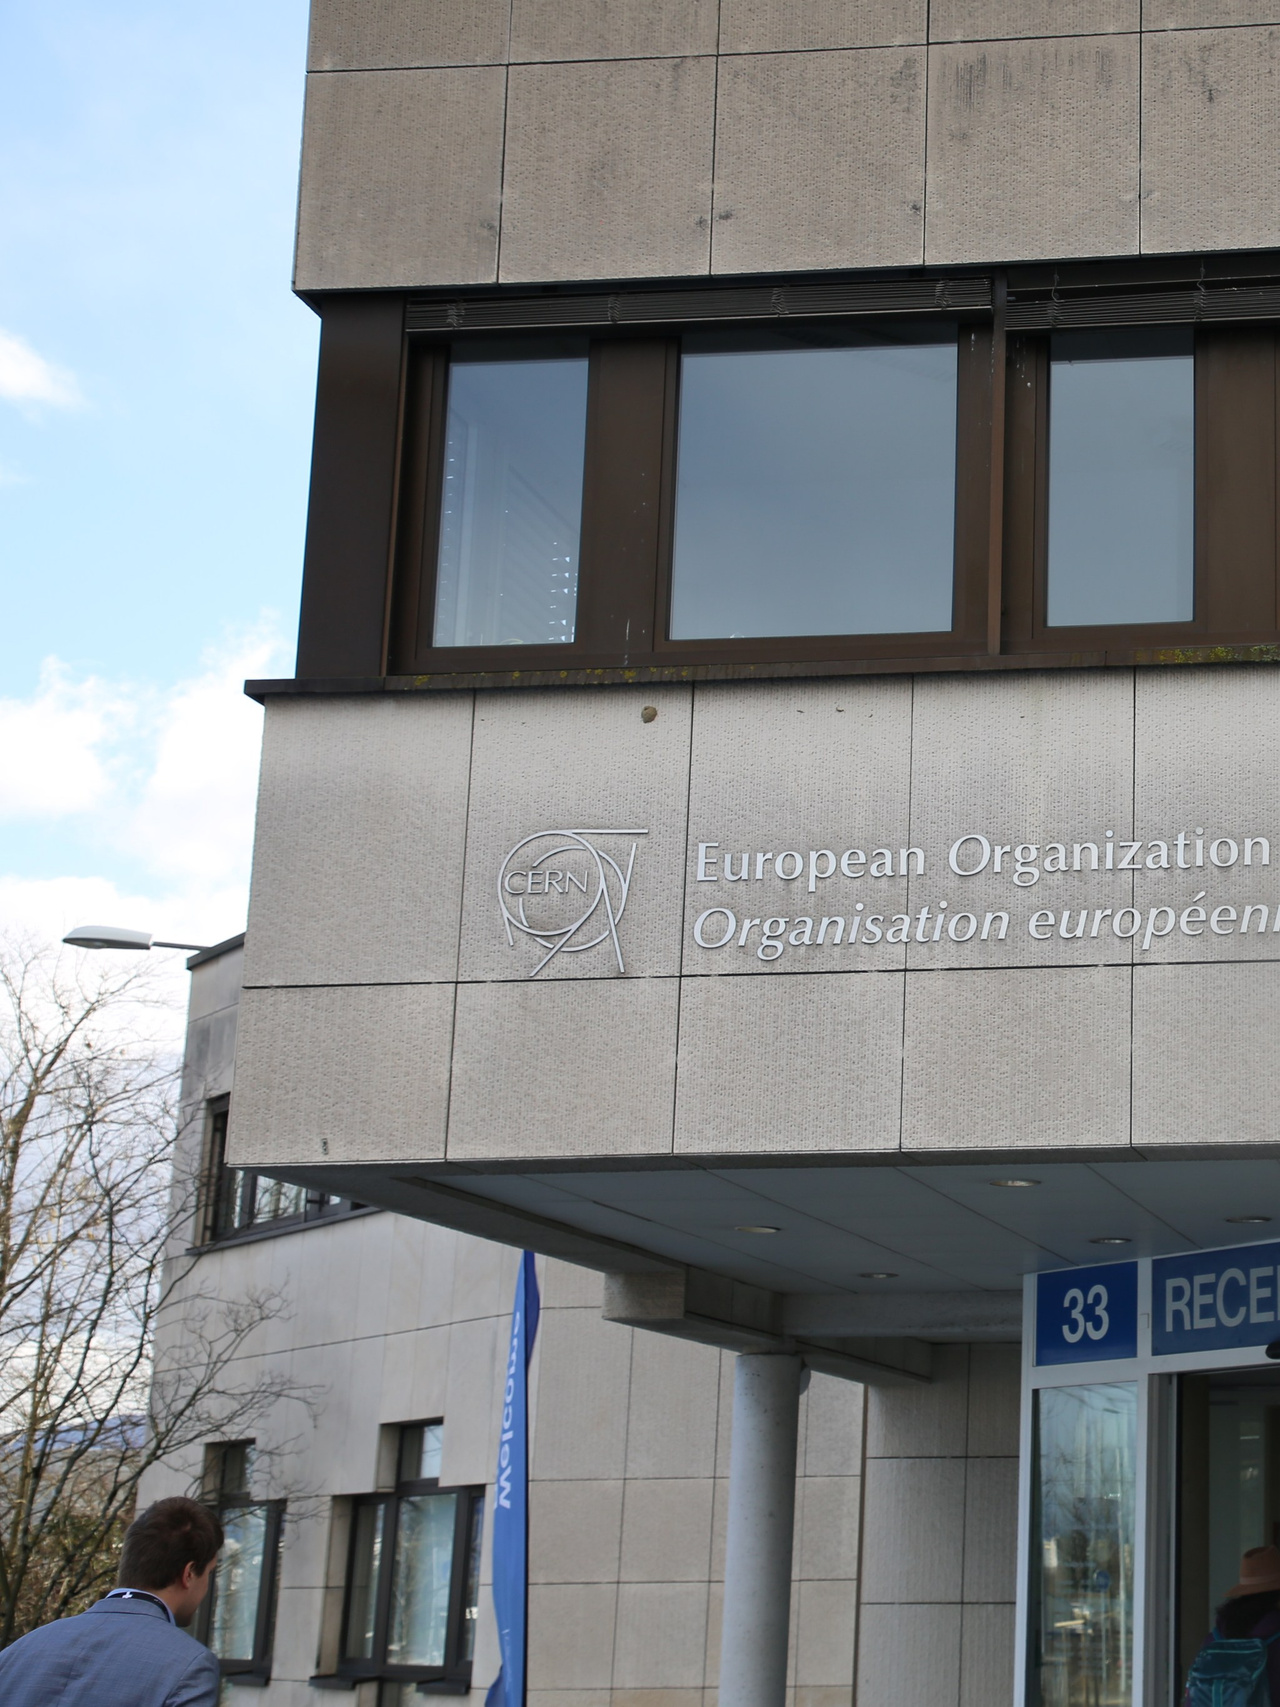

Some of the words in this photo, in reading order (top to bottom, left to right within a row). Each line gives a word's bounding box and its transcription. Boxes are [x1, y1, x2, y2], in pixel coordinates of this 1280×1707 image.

[504, 870, 588, 894] CERN
[696, 842, 925, 893] European
[949, 827, 1270, 887] Organization
[693, 901, 1010, 961] Organisation
[1062, 1285, 1110, 1343] 33
[499, 1311, 521, 1509] Welcome
